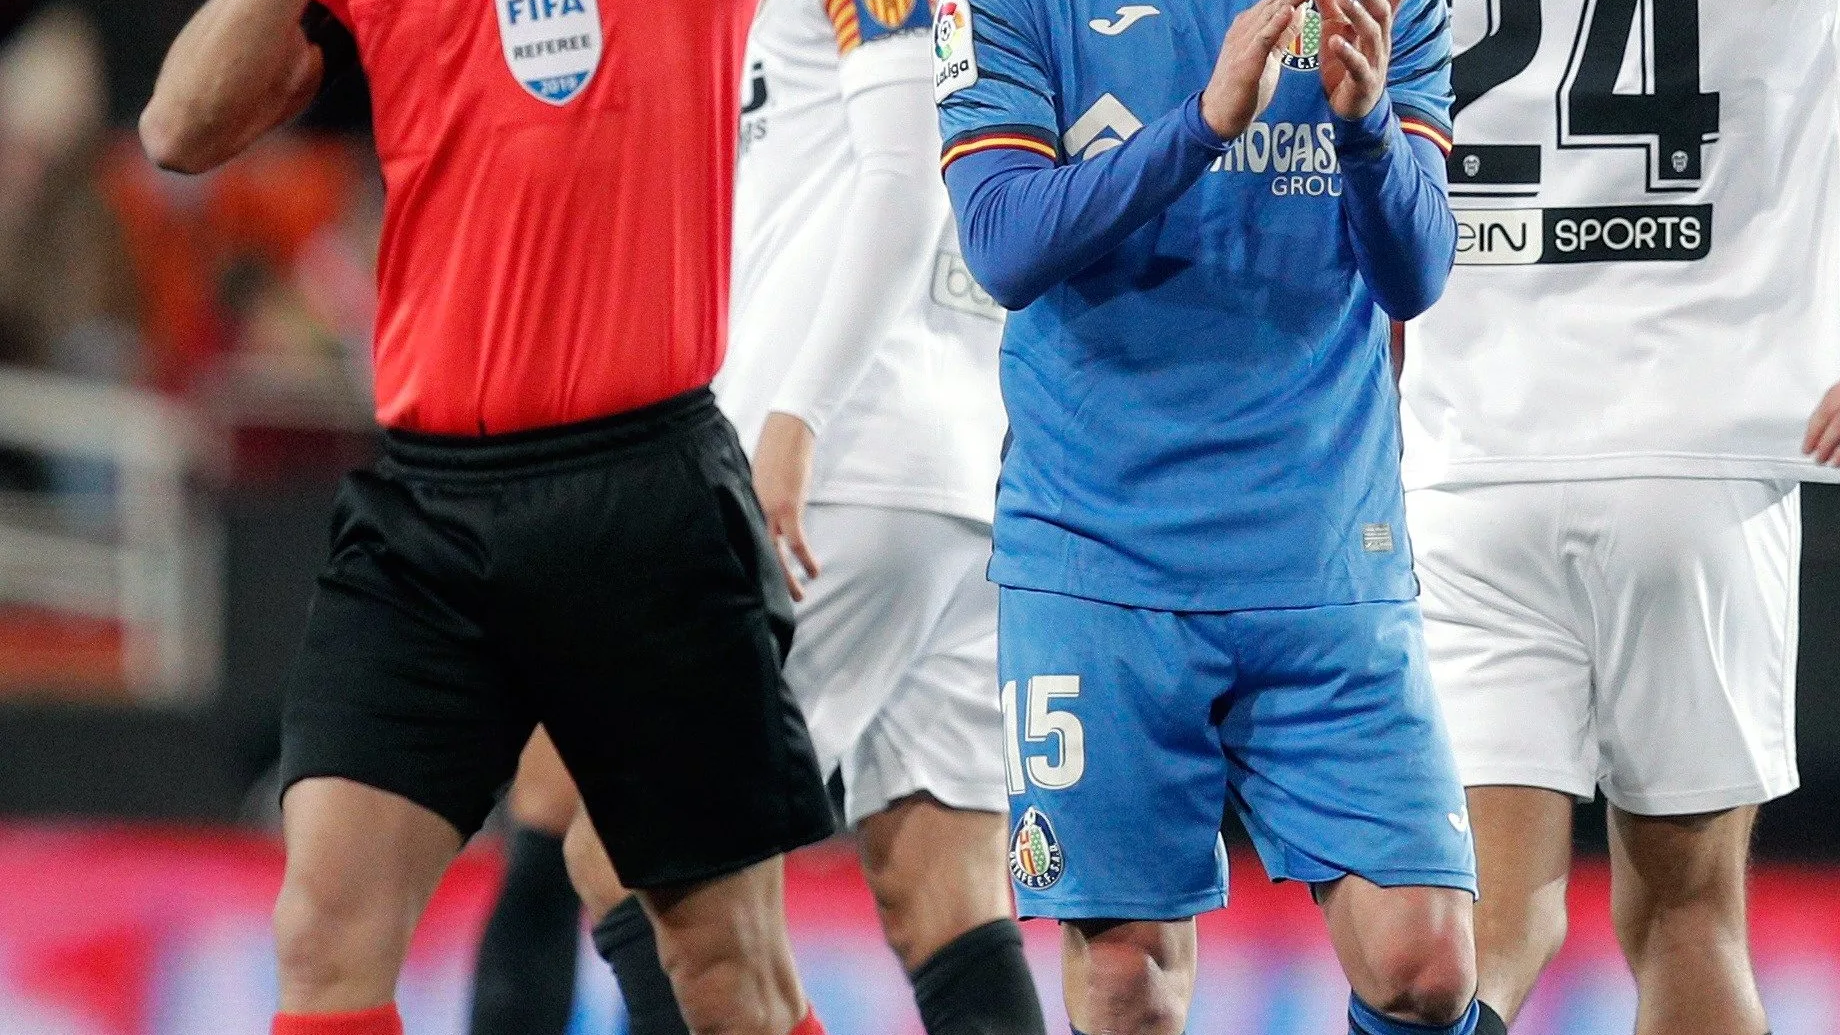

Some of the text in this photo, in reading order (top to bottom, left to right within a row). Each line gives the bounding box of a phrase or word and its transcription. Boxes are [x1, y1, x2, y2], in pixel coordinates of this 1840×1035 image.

[513, 34, 591, 61] REFEREE
[936, 59, 969, 87] LaLiga
[1271, 175, 1342, 197] GROU
[1457, 216, 1703, 254] eIN SPORTS
[1001, 674, 1085, 796] 15
